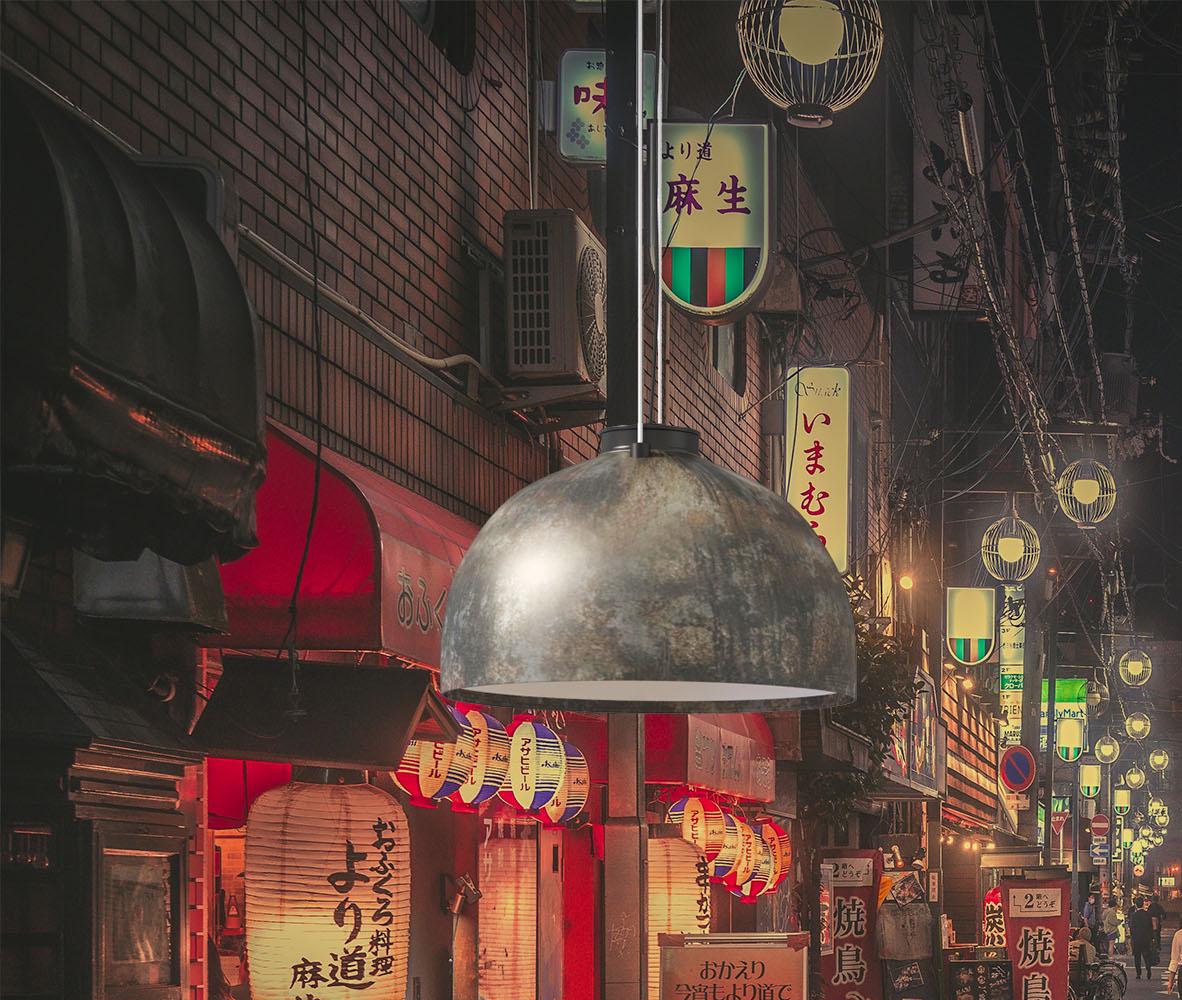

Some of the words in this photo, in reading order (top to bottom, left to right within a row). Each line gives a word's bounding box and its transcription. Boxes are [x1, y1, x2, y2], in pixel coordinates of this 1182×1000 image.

[661, 142, 712, 161] より道
[663, 173, 751, 216] 麻生
[520, 738, 531, 791] アサヒビール
[327, 840, 375, 991] より道
[368, 817, 396, 976] おふくろ料理
[832, 896, 867, 985] 焼鳥
[699, 960, 766, 980] おかえり
